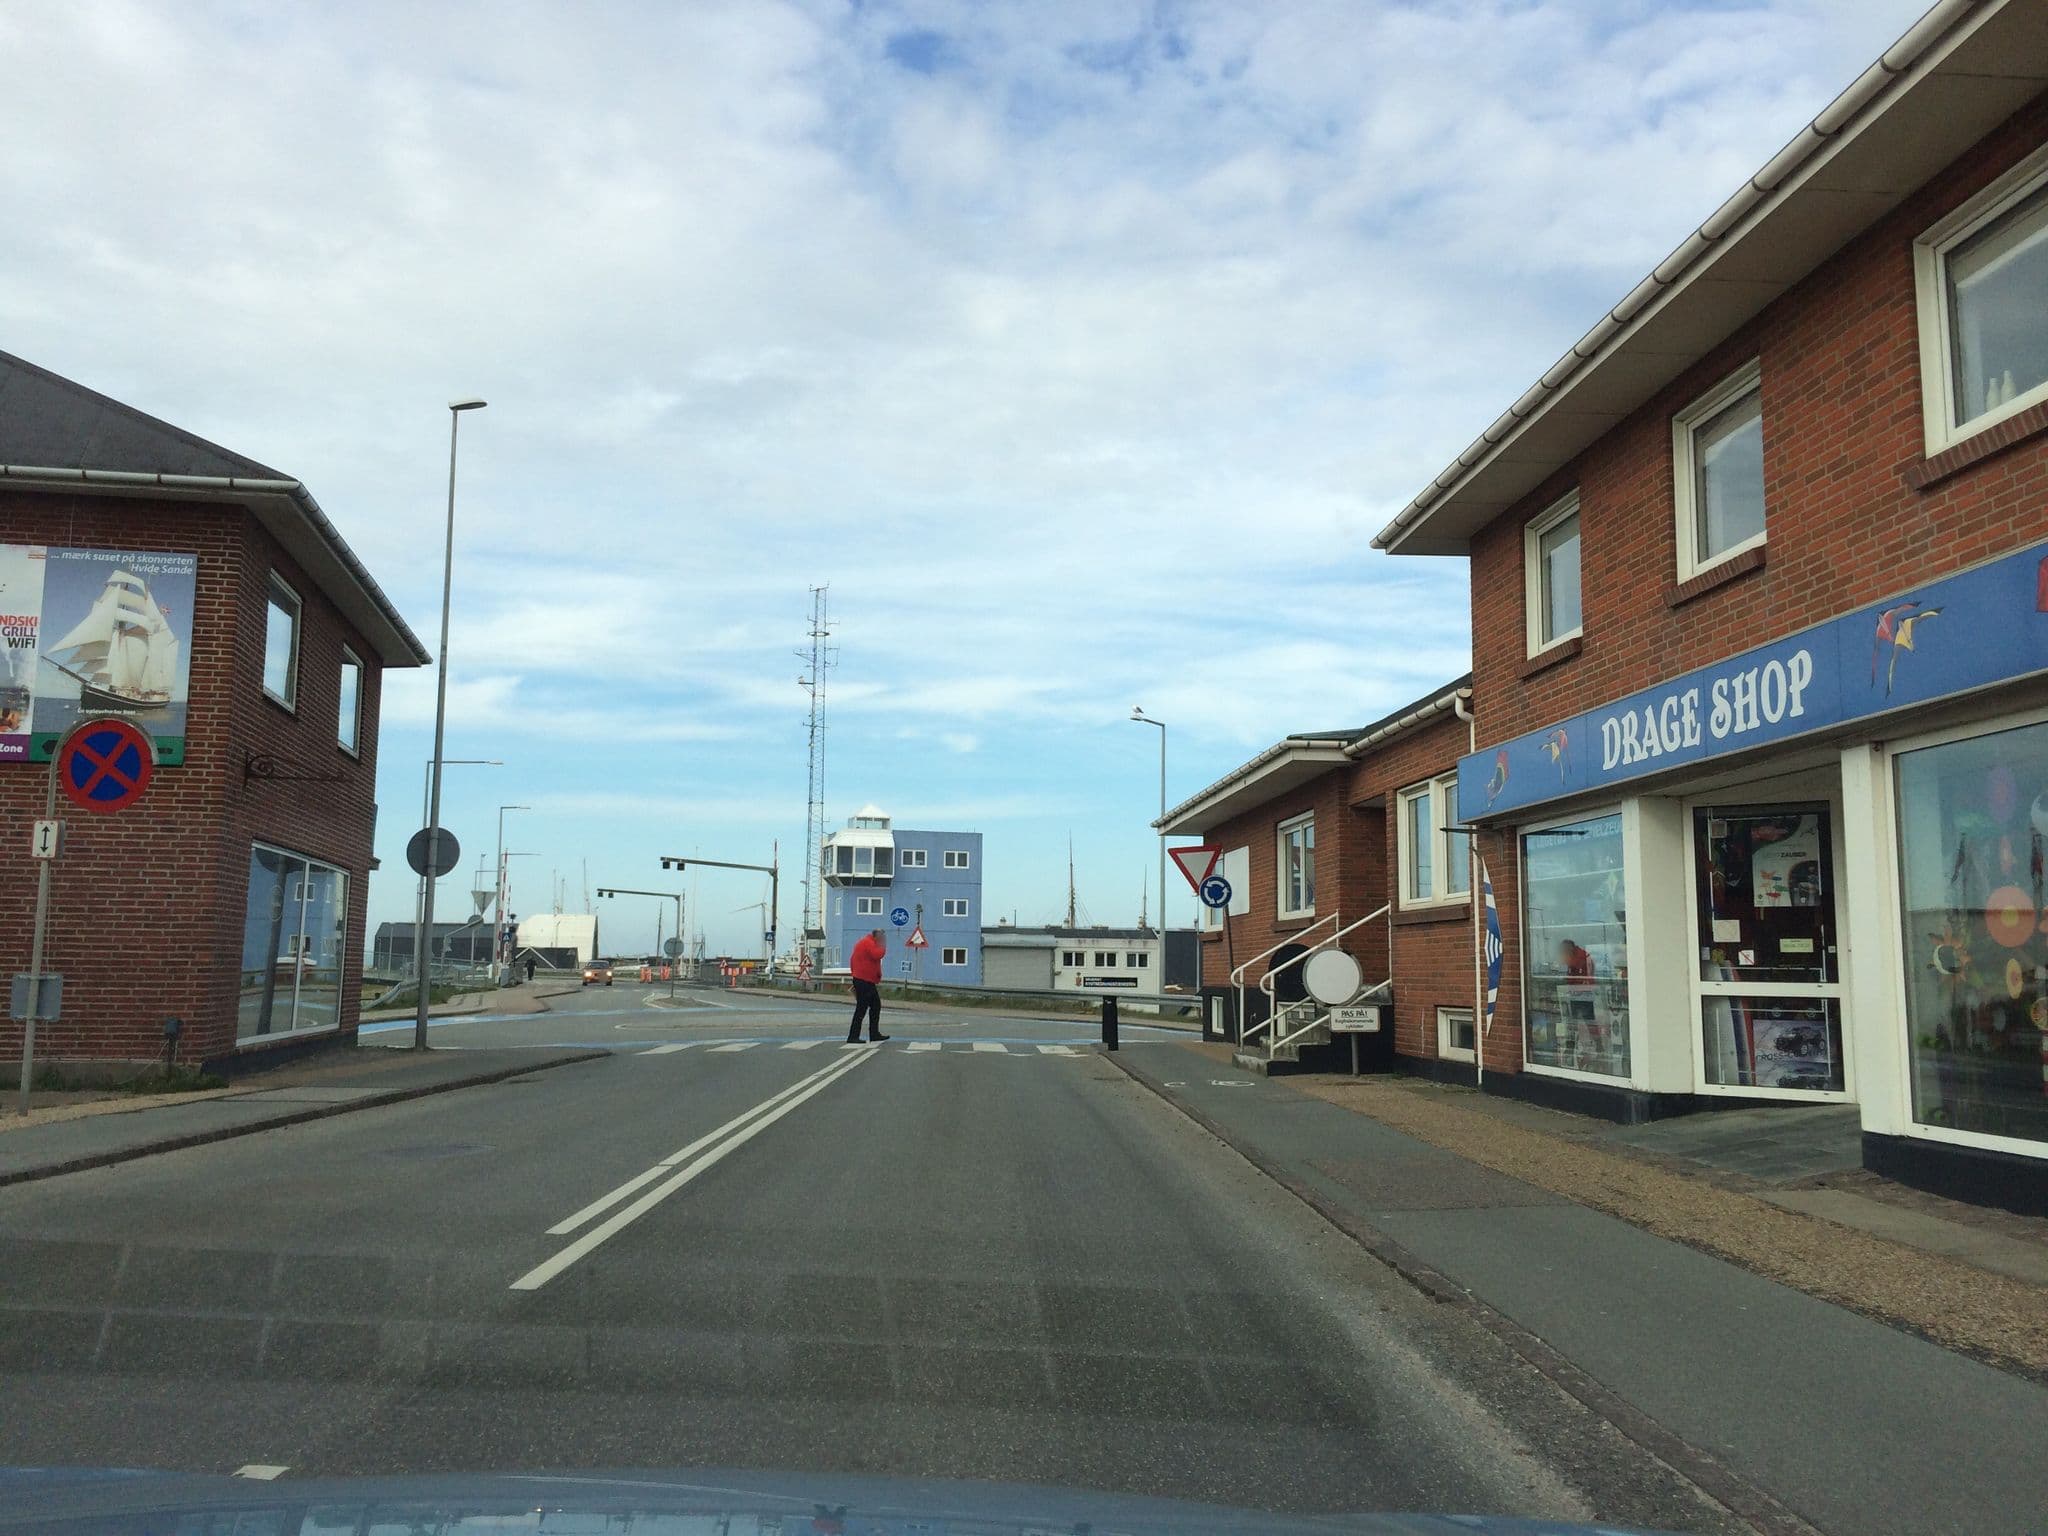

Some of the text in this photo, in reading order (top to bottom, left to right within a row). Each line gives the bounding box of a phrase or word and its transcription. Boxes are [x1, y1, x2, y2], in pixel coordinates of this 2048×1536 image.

[62, 551, 91, 560] mærk
[92, 552, 120, 562] suset
[121, 553, 136, 564] på
[137, 554, 194, 565] skonnerten
[131, 563, 193, 575] Hvide Sande
[2, 626, 37, 638] GRILL
[7, 637, 36, 649] WIFI
[1602, 649, 1813, 771] DRAGE SHOP
